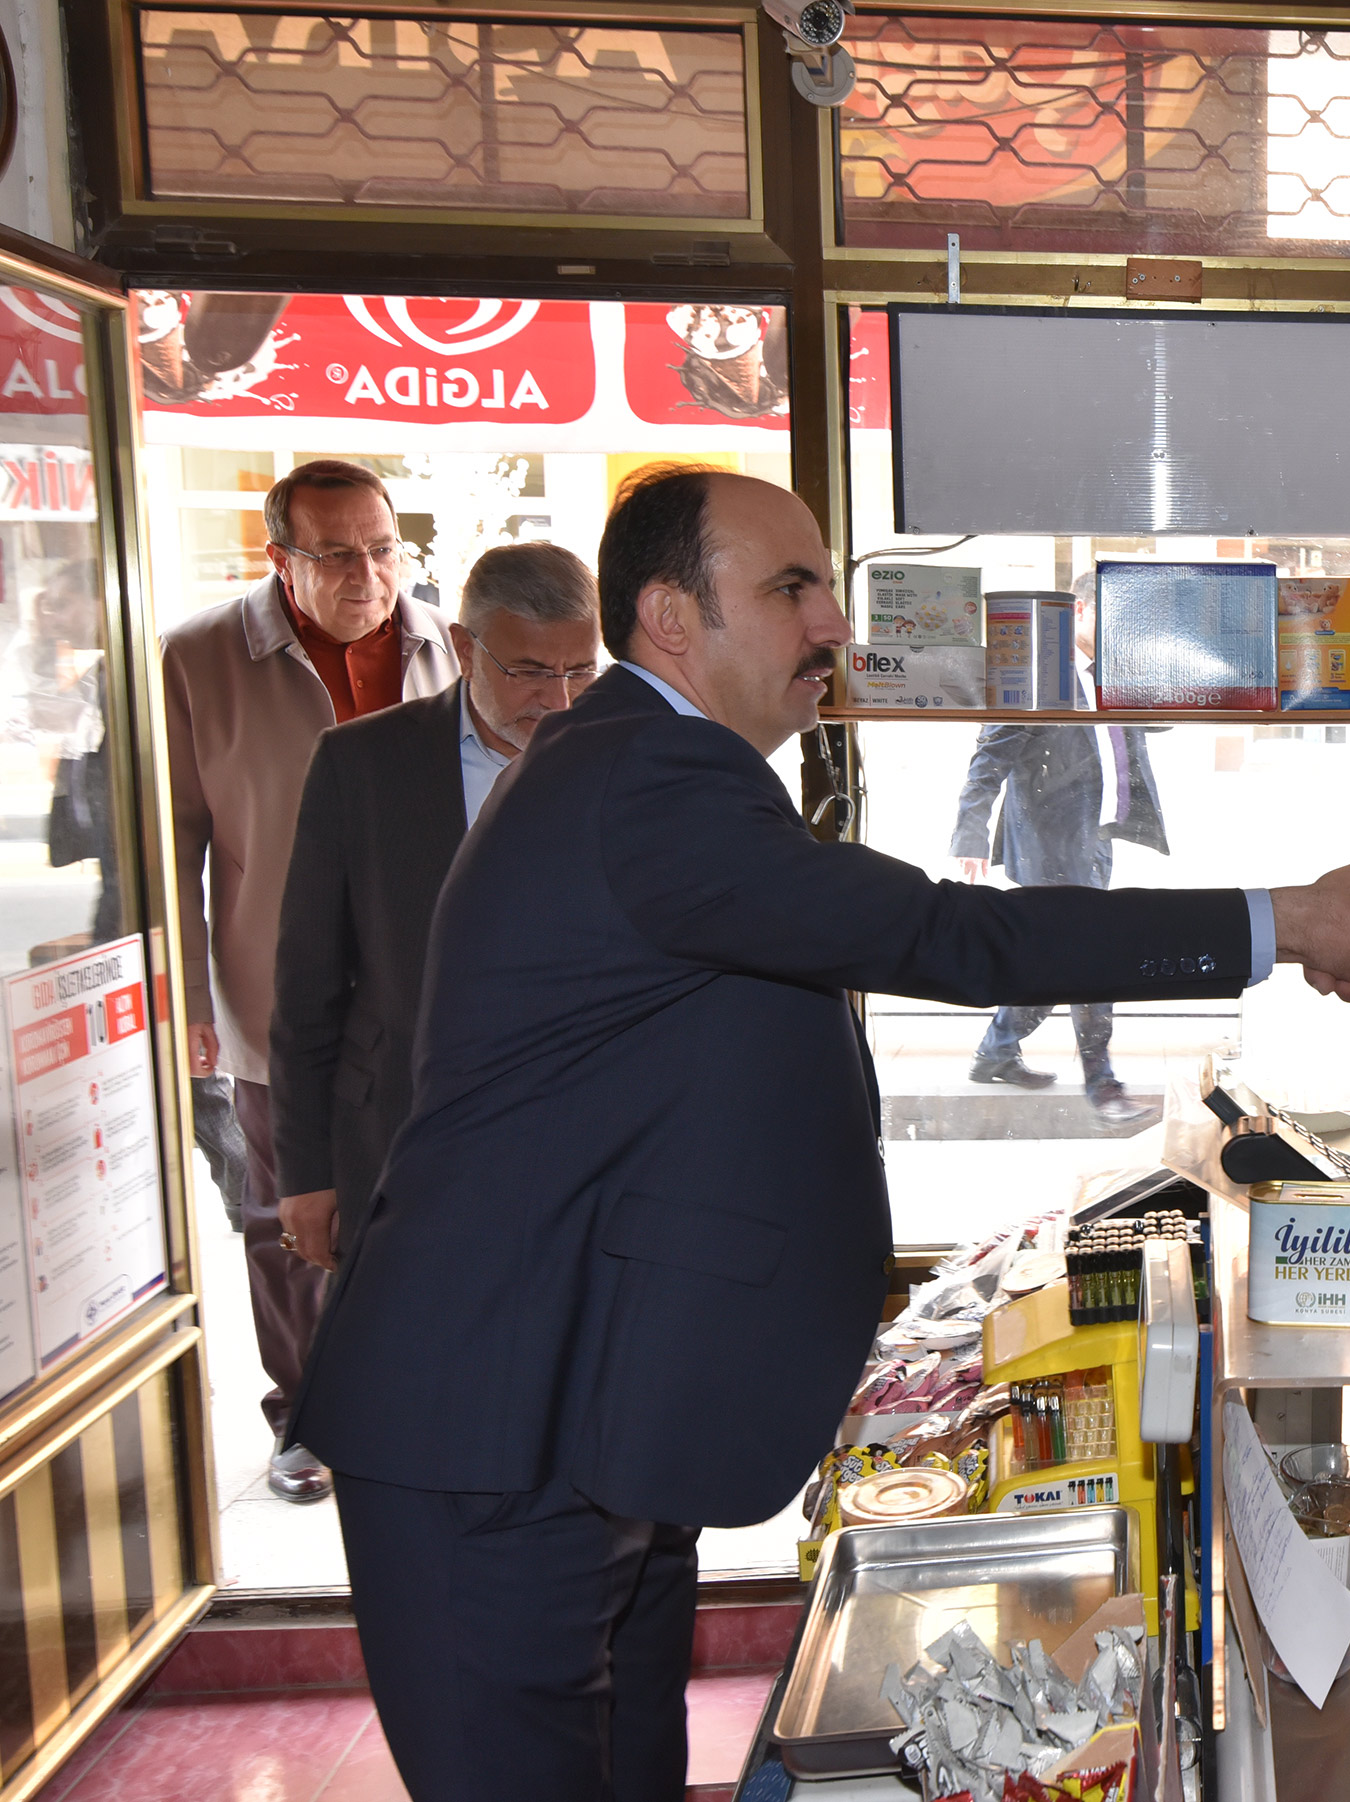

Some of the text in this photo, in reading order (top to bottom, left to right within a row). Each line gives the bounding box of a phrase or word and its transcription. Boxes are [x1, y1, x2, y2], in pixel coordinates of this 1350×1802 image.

[853, 652, 905, 672] bflex
[1305, 1257, 1326, 1266] HER
[1275, 1266, 1308, 1280] HER
